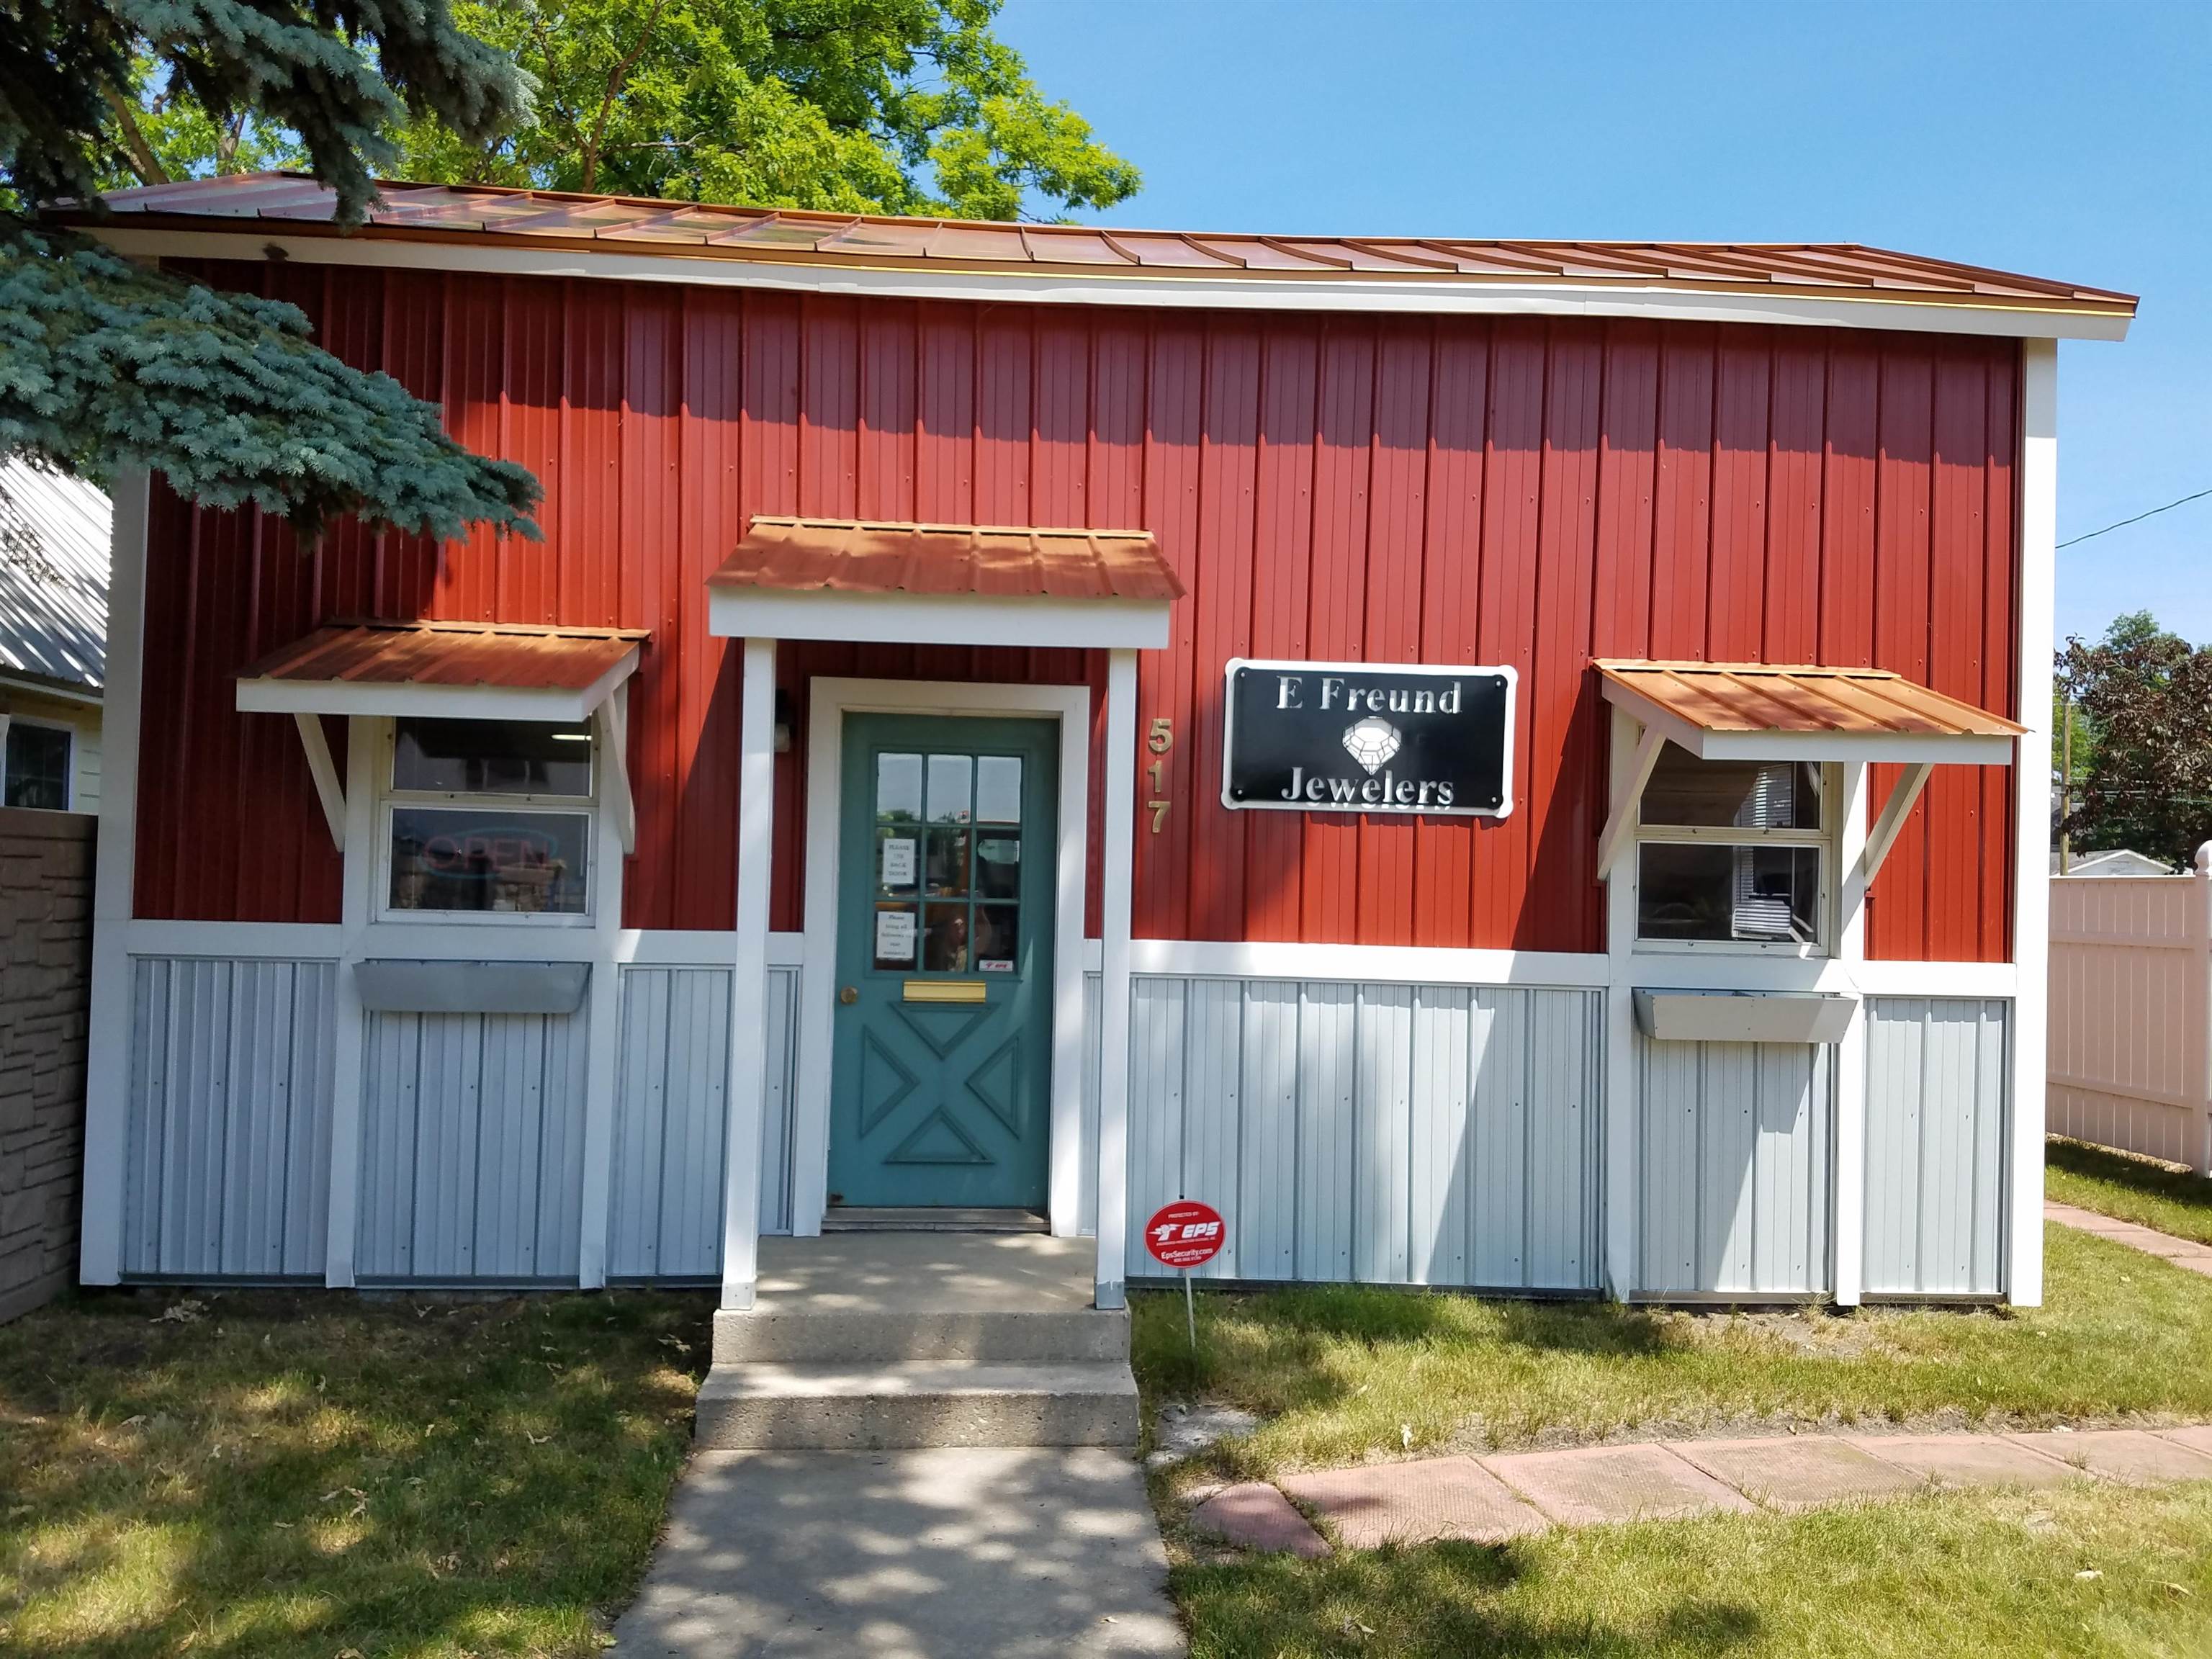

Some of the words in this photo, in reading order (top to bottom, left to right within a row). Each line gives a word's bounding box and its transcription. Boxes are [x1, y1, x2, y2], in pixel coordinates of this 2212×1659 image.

[1276, 675, 1303, 709] E
[1319, 677, 1462, 714] Freund
[1148, 718, 1174, 833] 517
[1281, 766, 1455, 806] Jewelers
[423, 835, 549, 871] OPEN
[1181, 1221, 1221, 1238] EPS
[1161, 1248, 1213, 1259] EpsSecurity.com
